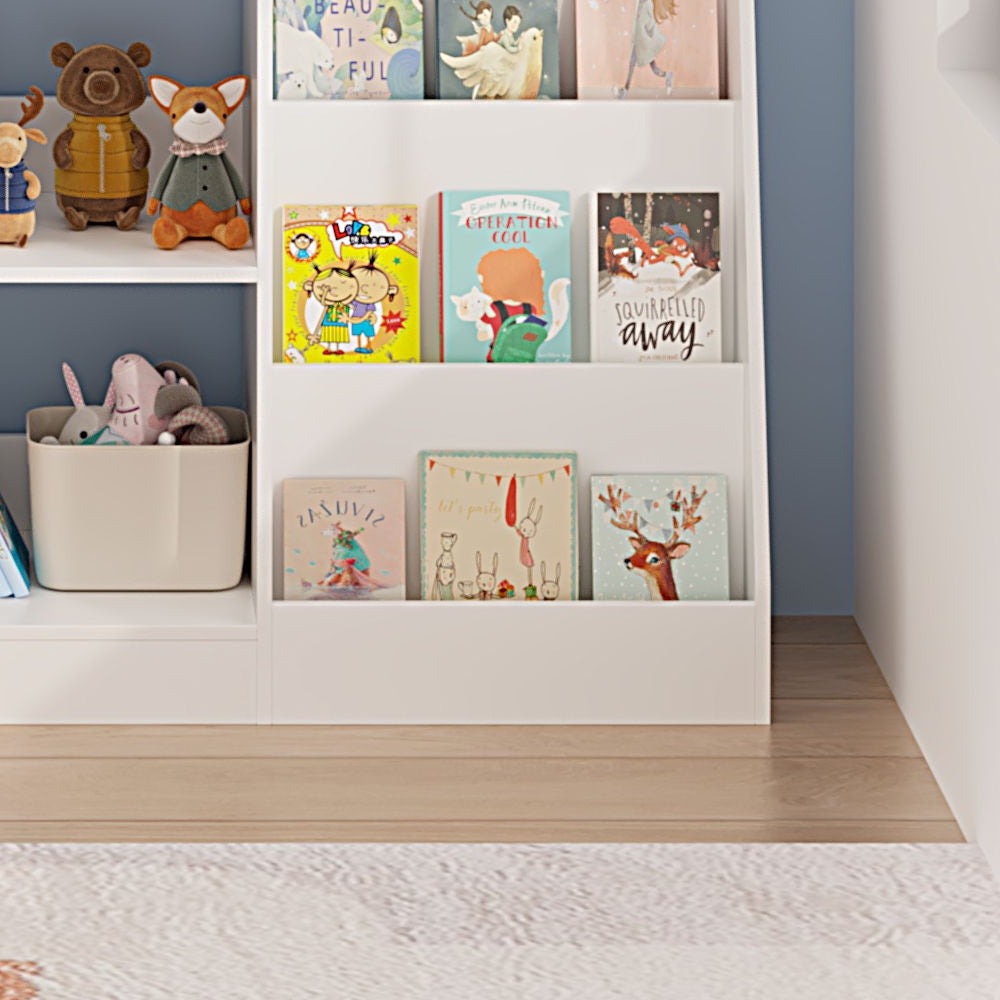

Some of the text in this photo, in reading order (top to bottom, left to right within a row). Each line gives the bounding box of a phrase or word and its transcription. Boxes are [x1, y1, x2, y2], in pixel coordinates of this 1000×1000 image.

[332, 27, 367, 48] TI-
[348, 61, 389, 81] FUL
[465, 215, 559, 230] OPERATION
[491, 230, 531, 244] COOL
[614, 296, 706, 326] SQUIRRELLED
[618, 320, 705, 361] away
